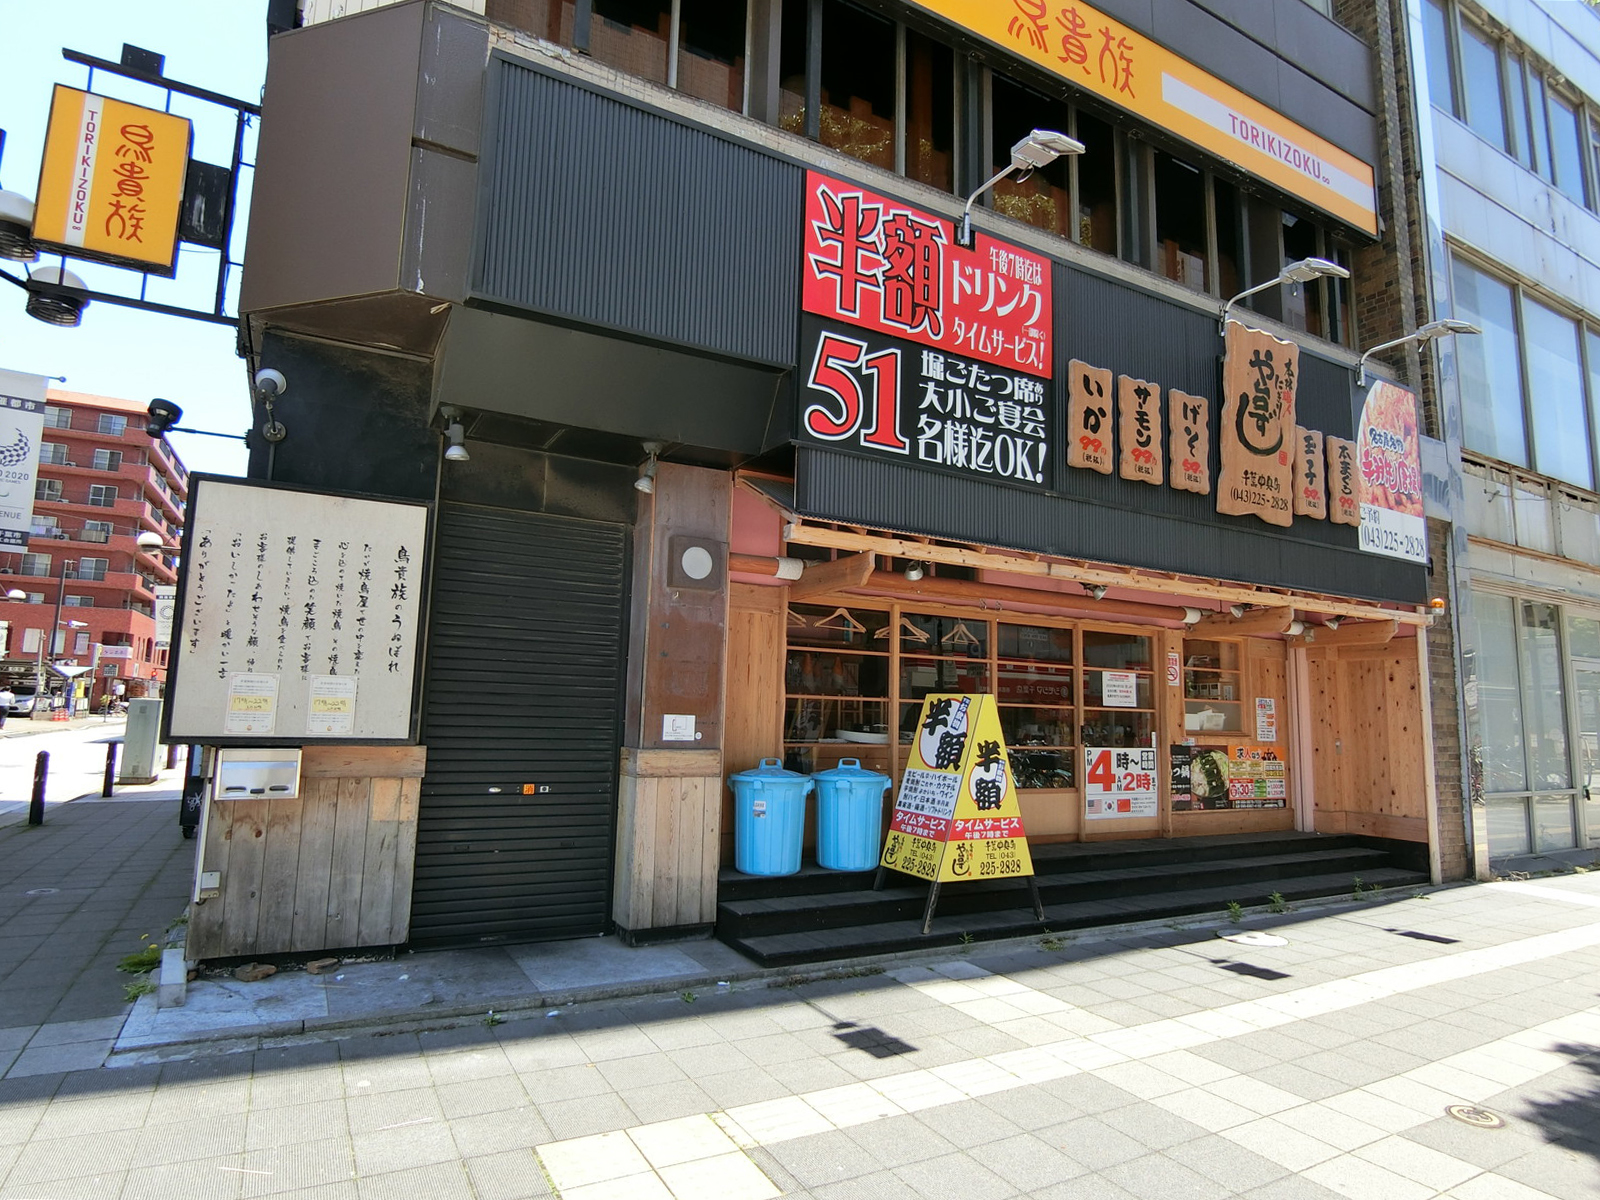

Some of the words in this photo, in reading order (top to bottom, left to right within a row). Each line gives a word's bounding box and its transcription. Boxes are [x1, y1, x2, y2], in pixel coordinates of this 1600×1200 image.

[73, 109, 98, 223] TORIKIZOKU
[1228, 113, 1321, 180] TORIKIZOKU
[105, 124, 155, 243] 鳥貴族
[808, 184, 948, 340] 半額
[952, 260, 1042, 326] ドリンク
[952, 317, 1045, 370] タイムサービス!
[804, 331, 910, 455] 51
[918, 381, 1045, 438] 大小ご宴会
[1083, 374, 1107, 434] いか
[1133, 385, 1151, 447] サーモン
[917, 414, 1047, 483] 名様迄OK!
[1183, 402, 1202, 457] げそ
[5, 471, 29, 480] 2020
[1303, 435, 1316, 486] 玉子
[1338, 445, 1352, 495] 本まぐろ
[1230, 487, 1289, 511] (043)225-2828
[1361, 525, 1425, 558] (043)225-2828
[388, 545, 410, 673] 鳥貴族のうぬぼれ
[922, 697, 968, 771] 半額
[974, 740, 1002, 811] 半額
[1171, 765, 1190, 778] つ鍋
[896, 811, 946, 831] タイムサービス
[900, 824, 935, 837] 午後7時まで
[955, 818, 1020, 831] タイムサービス
[965, 830, 1009, 840] 午後7時まで
[901, 856, 937, 878] 225-2828
[980, 859, 1021, 875] 225-2828
